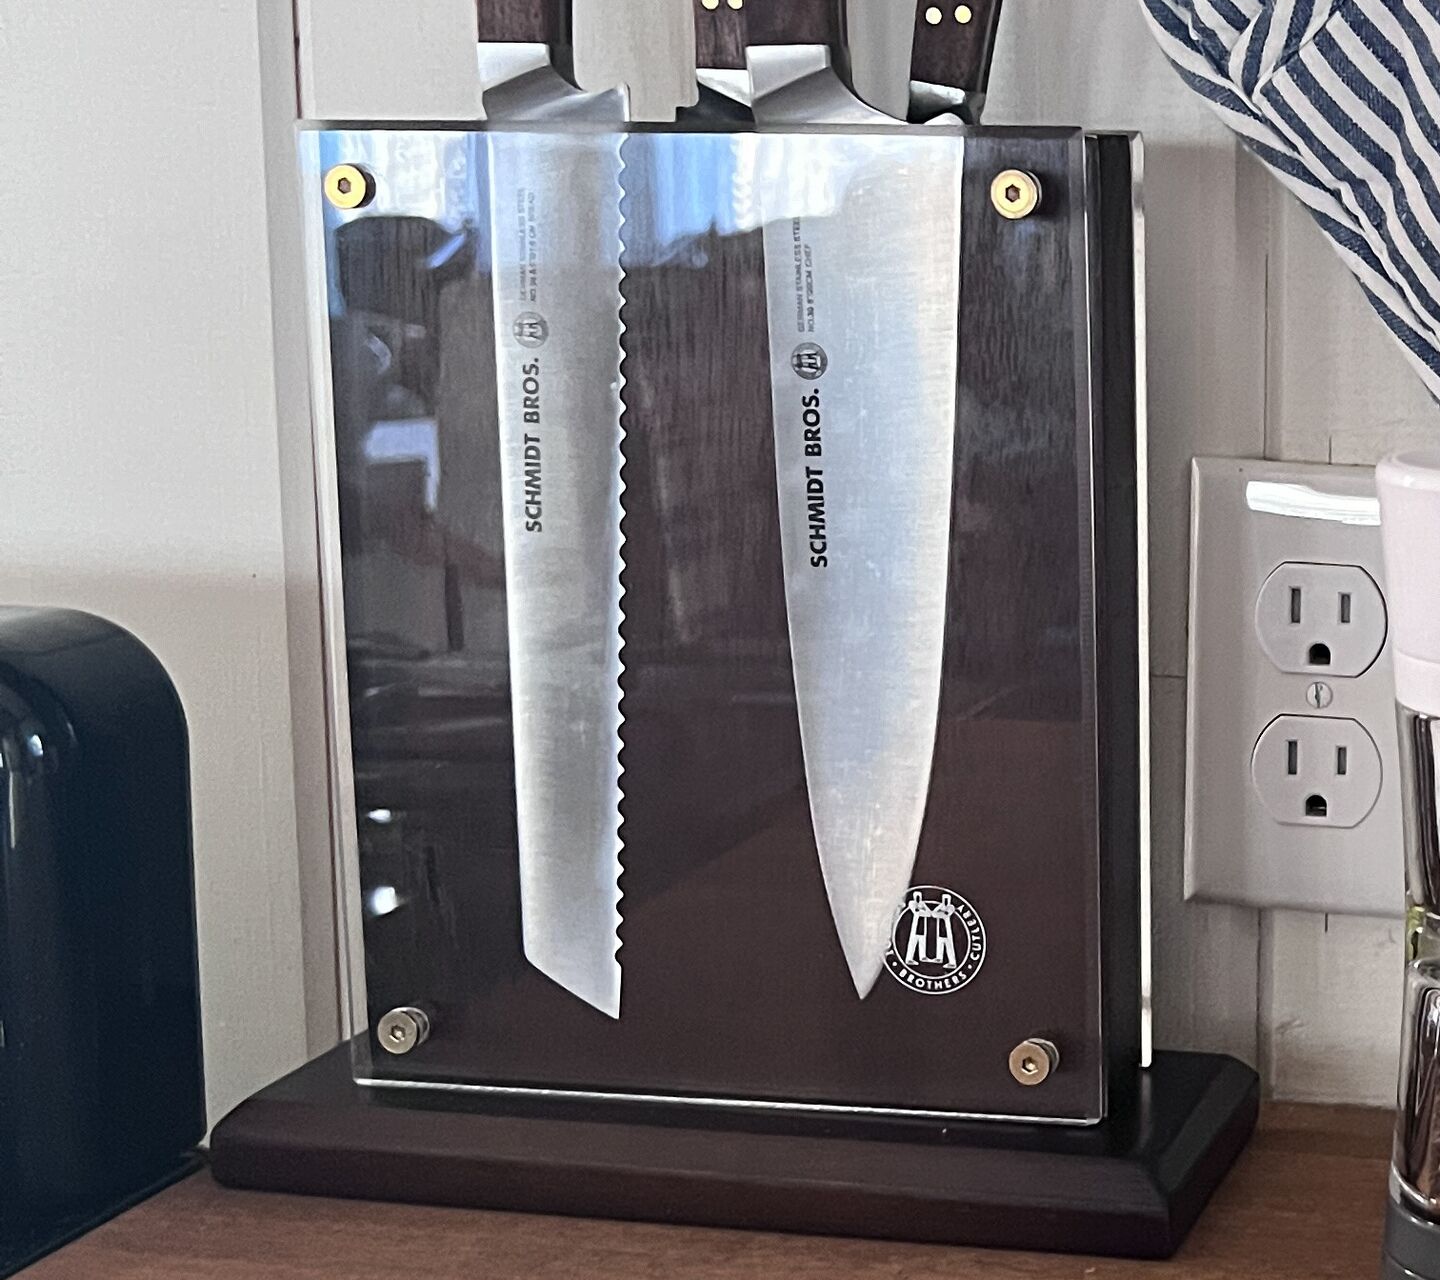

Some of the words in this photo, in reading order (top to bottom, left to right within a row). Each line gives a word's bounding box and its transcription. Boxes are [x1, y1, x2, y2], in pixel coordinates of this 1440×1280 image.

[522, 357, 540, 424] BROS.
[802, 388, 822, 457] BROS.
[524, 433, 542, 532] SCHMIDT
[805, 466, 828, 568] SCHMIDT
[899, 968, 967, 990] BROTHERS
